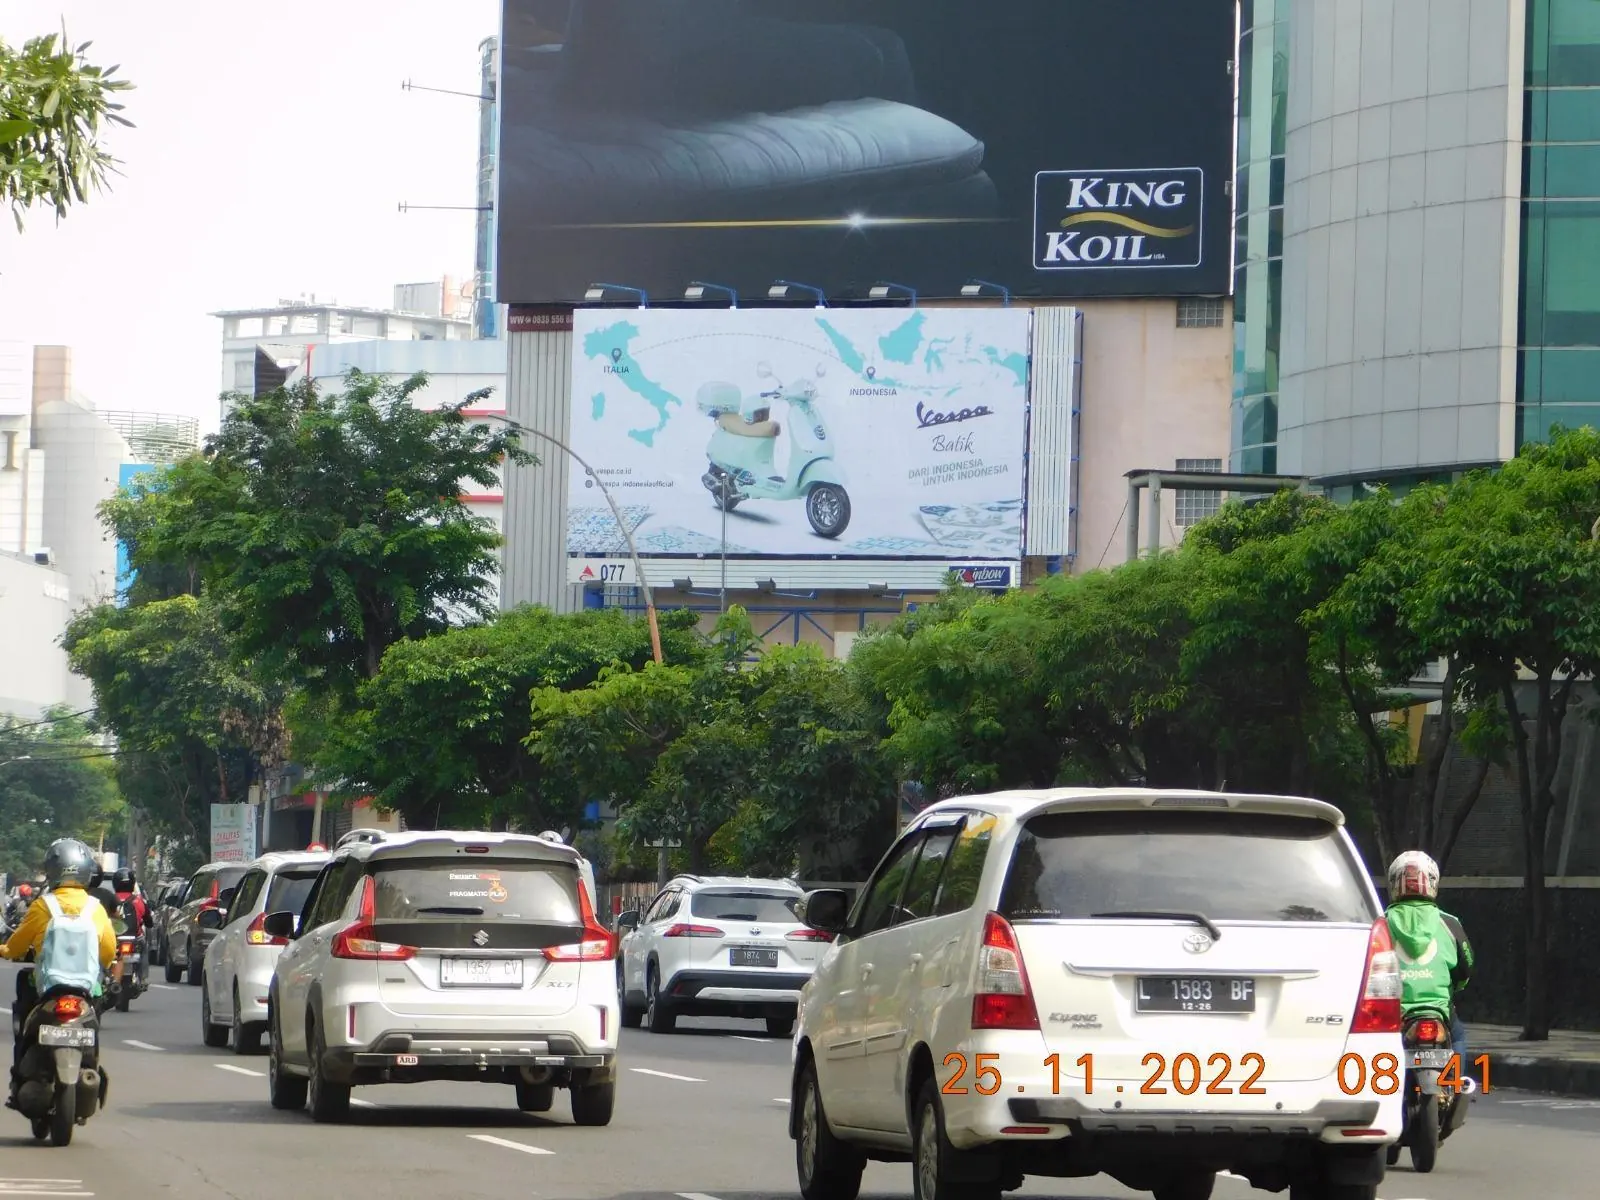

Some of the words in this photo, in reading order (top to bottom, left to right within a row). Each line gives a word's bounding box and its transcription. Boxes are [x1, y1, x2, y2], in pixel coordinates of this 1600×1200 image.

[1066, 178, 1186, 208] KING
[1043, 232, 1153, 261] KOIL
[603, 366, 630, 374] ITALIA
[849, 388, 898, 397] INDONESIA
[916, 401, 995, 430] Vespa
[932, 432, 975, 455] Batik
[908, 467, 930, 480] DARI
[932, 458, 984, 475] INDONESIA
[922, 473, 954, 487] UNTUK
[957, 464, 1009, 481] INDONESIA
[600, 564, 626, 581] 077
[1401, 968, 1434, 981] gojek
[1140, 979, 1151, 1000] L
[1171, 980, 1213, 1001] 1583
[1231, 980, 1253, 1001] BF
[398, 1055, 417, 1065] ARB
